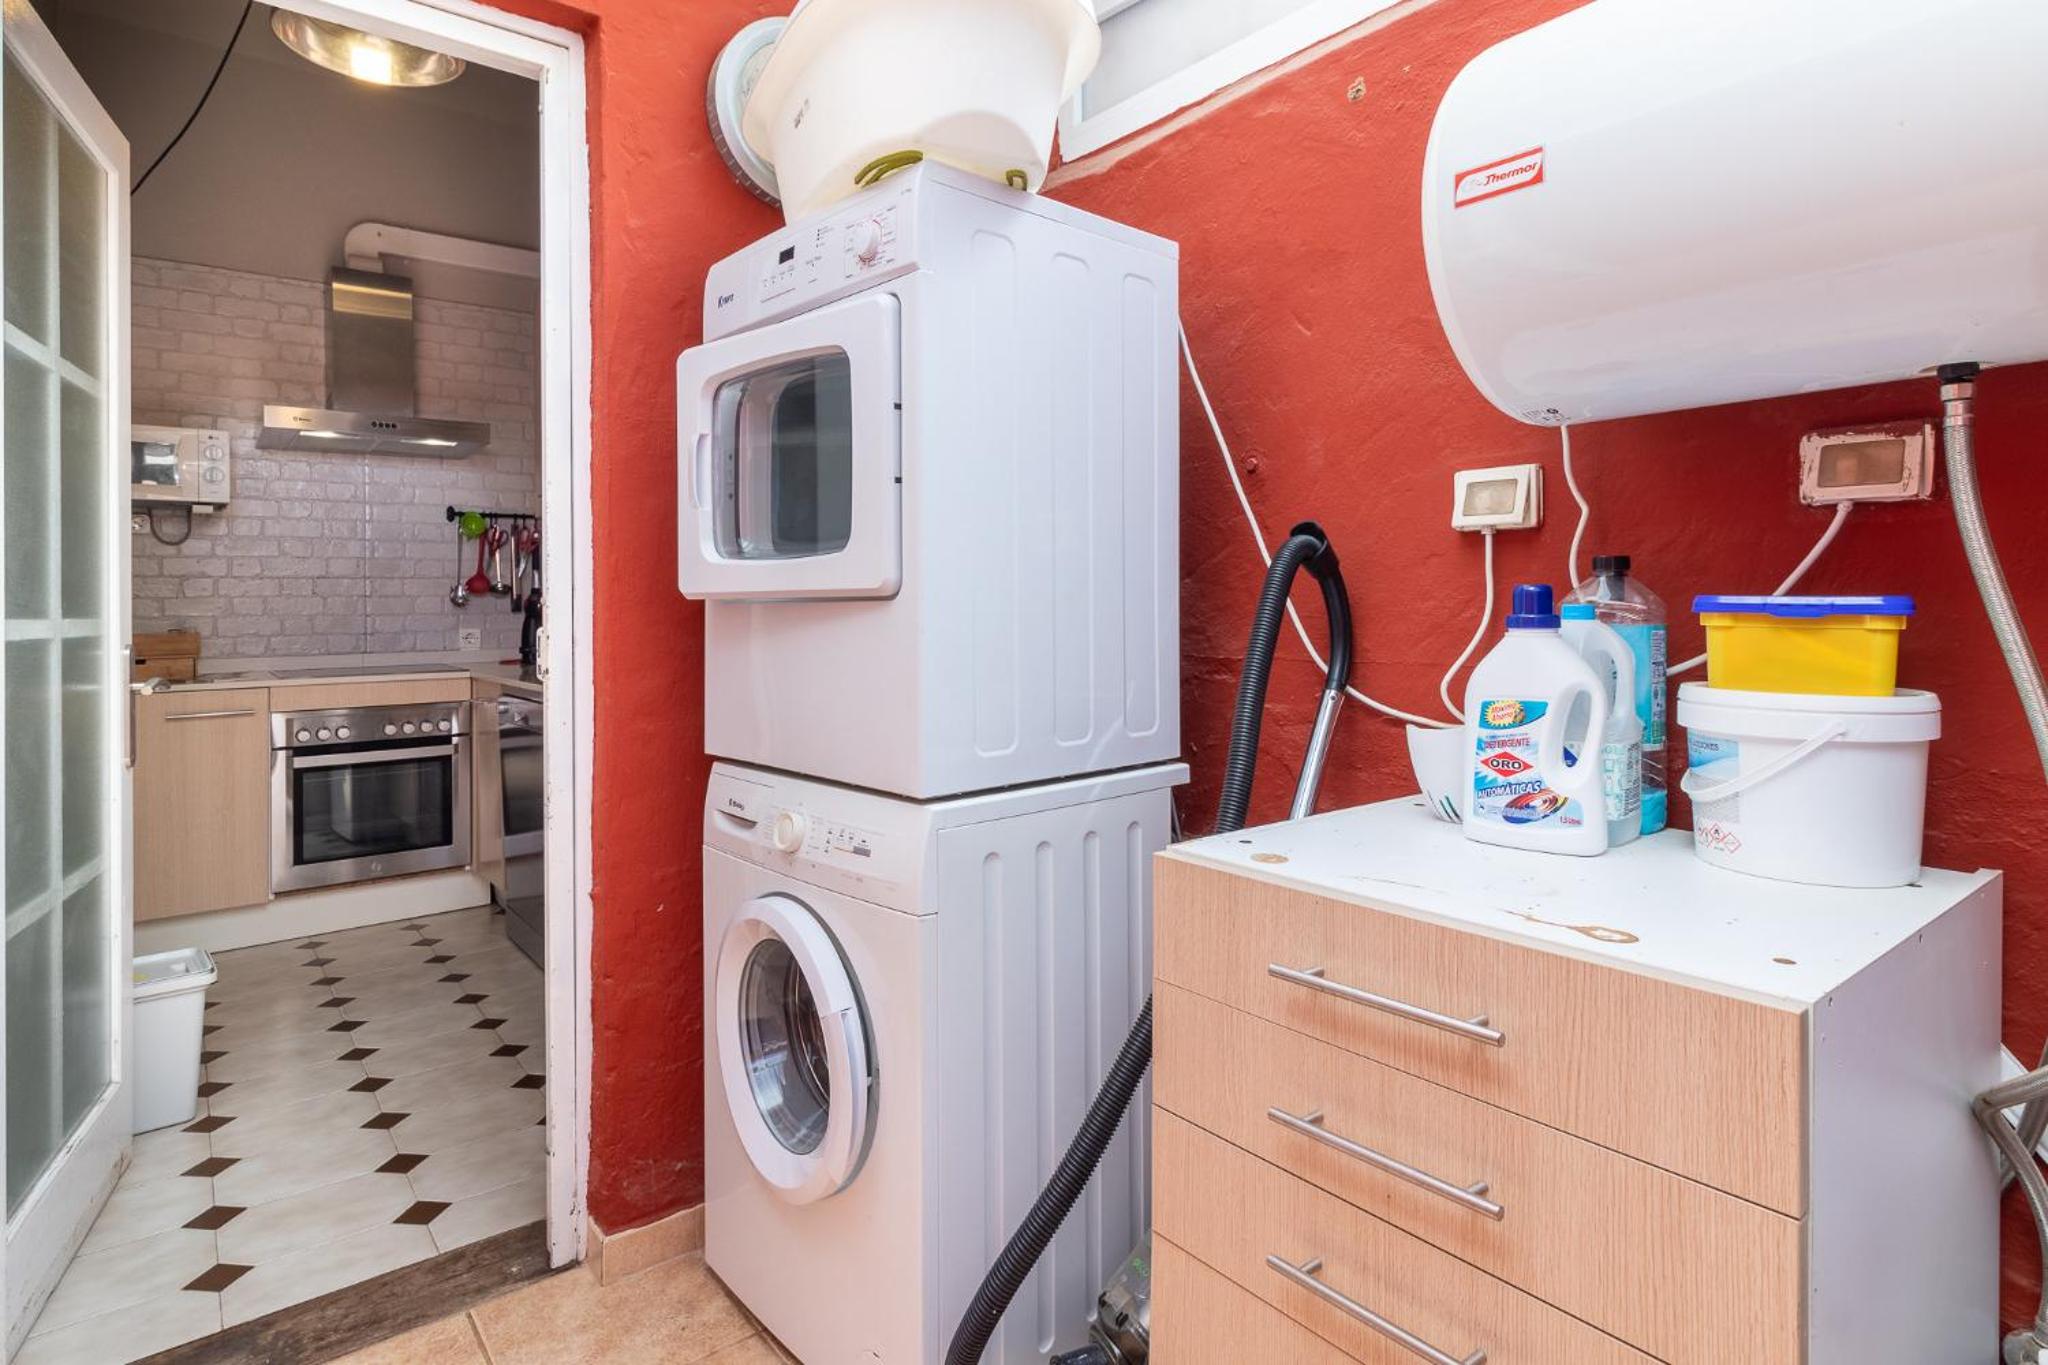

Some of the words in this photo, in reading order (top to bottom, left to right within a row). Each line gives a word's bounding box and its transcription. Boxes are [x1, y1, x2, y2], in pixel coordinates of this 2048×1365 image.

[1485, 162, 1538, 186] Thermor
[1484, 737, 1531, 749] DETERGENTE
[1490, 759, 1522, 770] ORO
